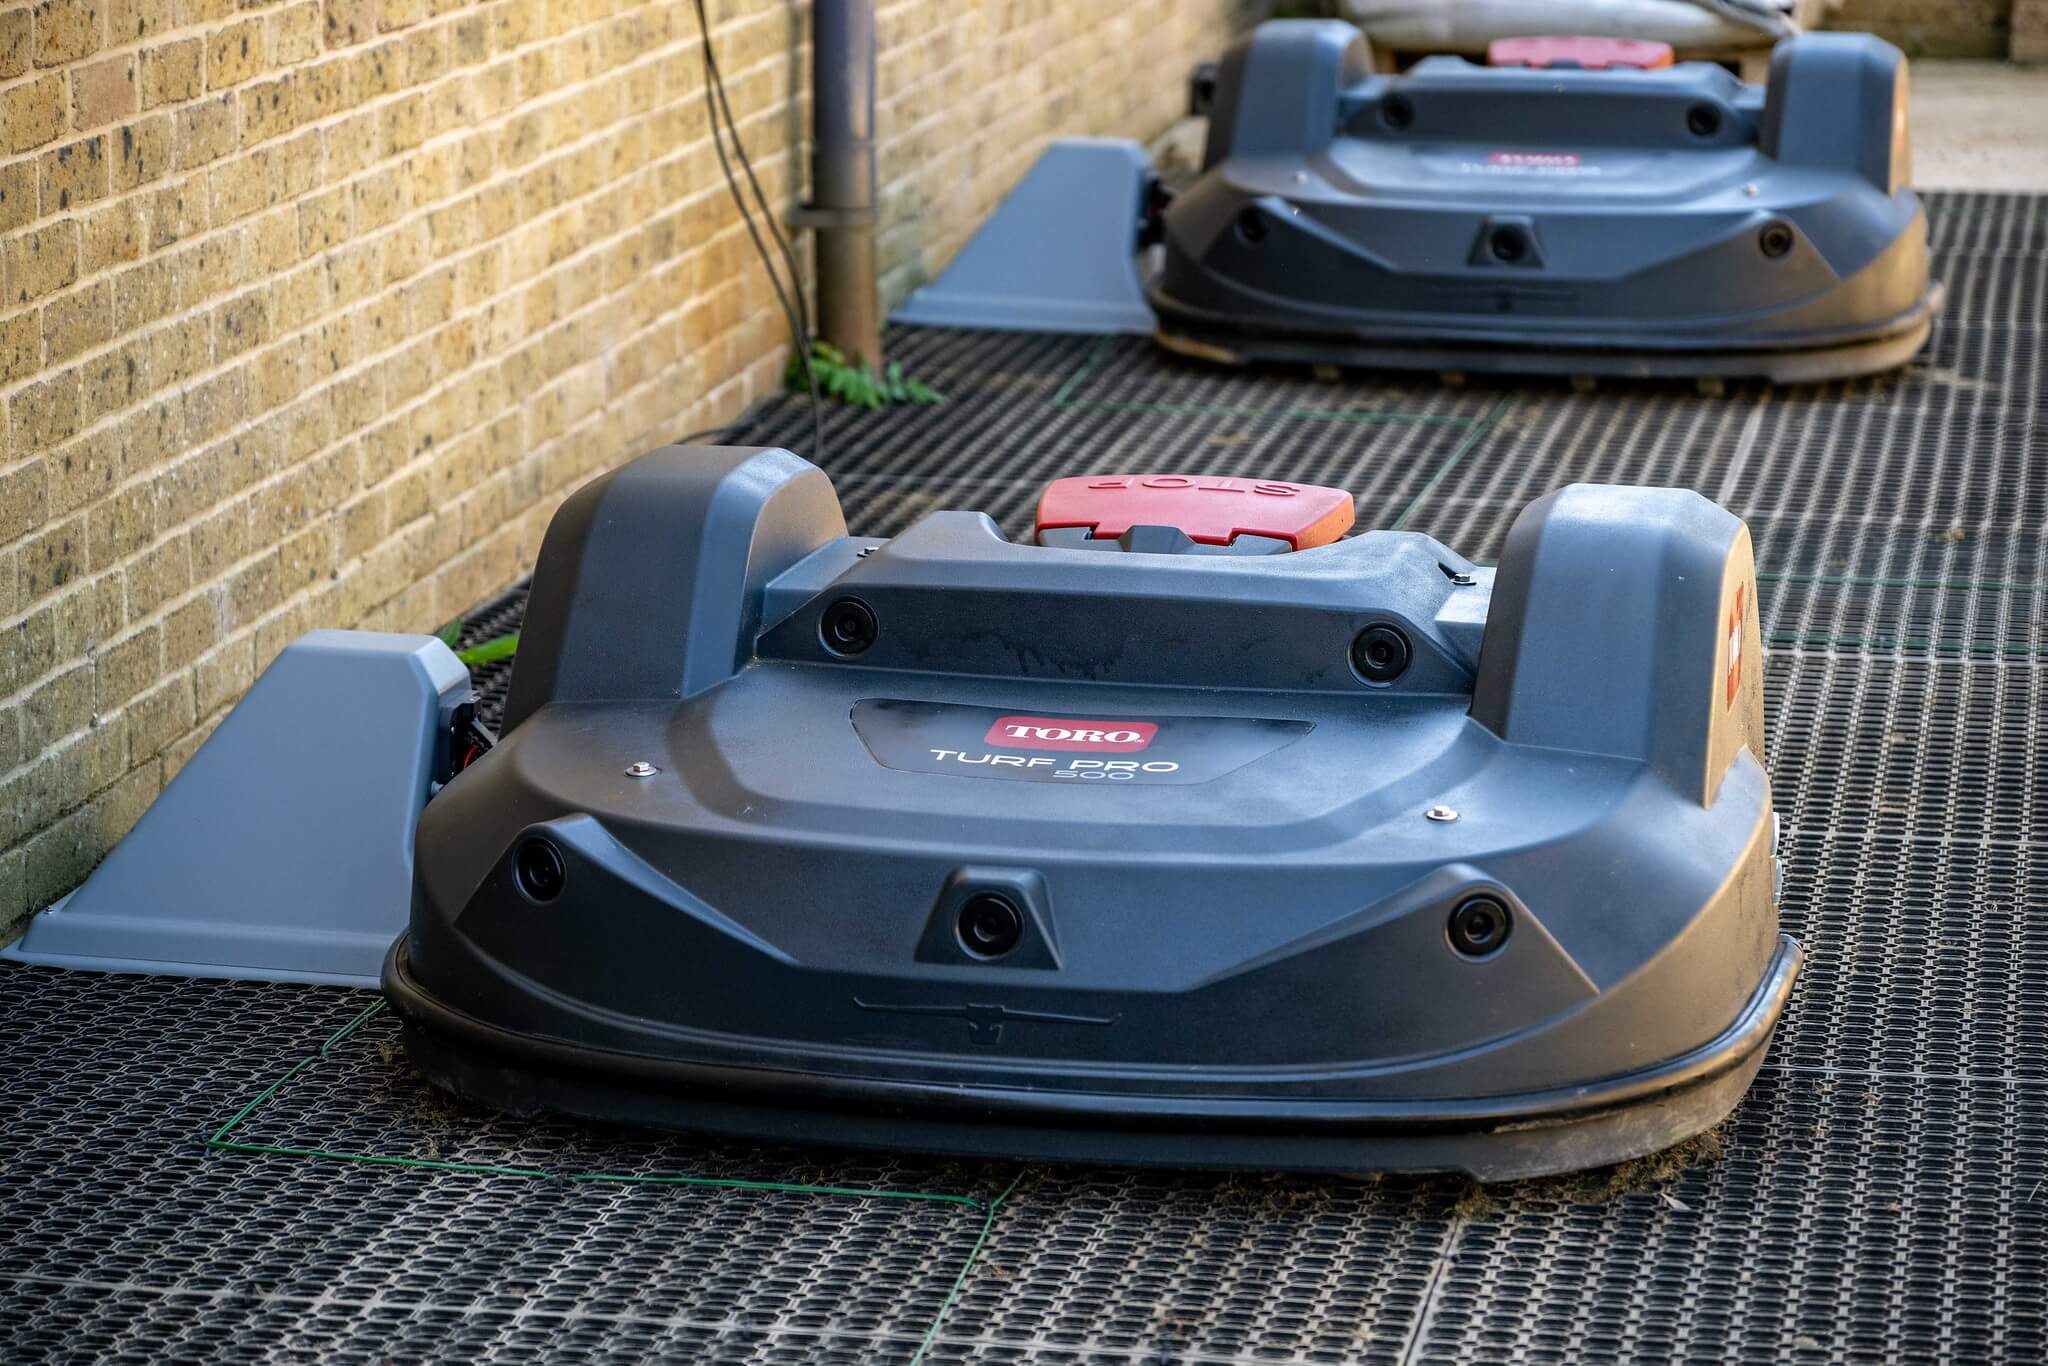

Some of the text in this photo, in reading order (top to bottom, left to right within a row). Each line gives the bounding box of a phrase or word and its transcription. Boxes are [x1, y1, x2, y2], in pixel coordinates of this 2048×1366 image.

[1087, 477, 1301, 497] STOP
[1005, 724, 1143, 743] TORO
[930, 748, 1180, 773] TURF PRO
[1051, 769, 1135, 781] 500
